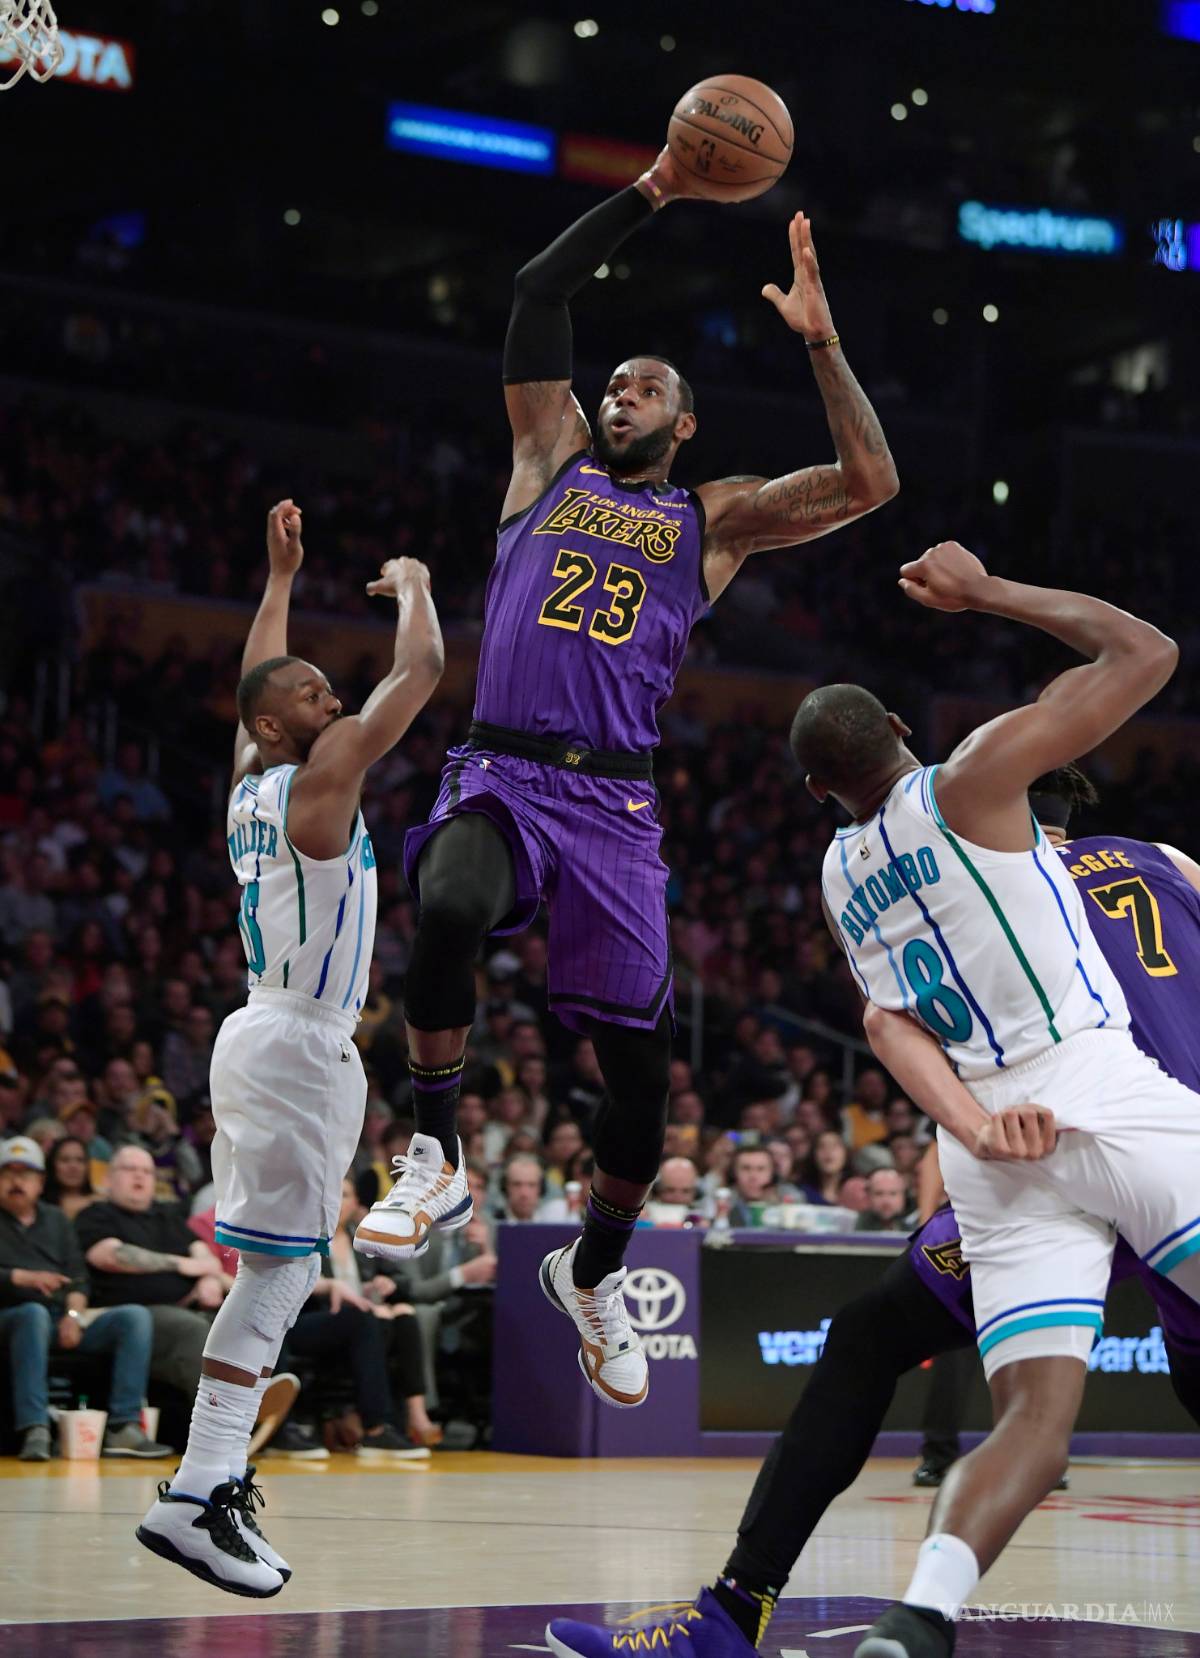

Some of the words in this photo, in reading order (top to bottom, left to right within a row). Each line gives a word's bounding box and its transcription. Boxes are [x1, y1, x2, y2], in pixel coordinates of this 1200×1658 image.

[532, 487, 682, 564] LAKERS
[588, 494, 618, 508] LOS
[618, 504, 683, 528] ANGELES
[537, 548, 648, 646] 23
[840, 845, 941, 947] BIYOMBO
[1071, 849, 1136, 881] cGEE
[1086, 875, 1179, 977] 7
[902, 938, 973, 1043] 8
